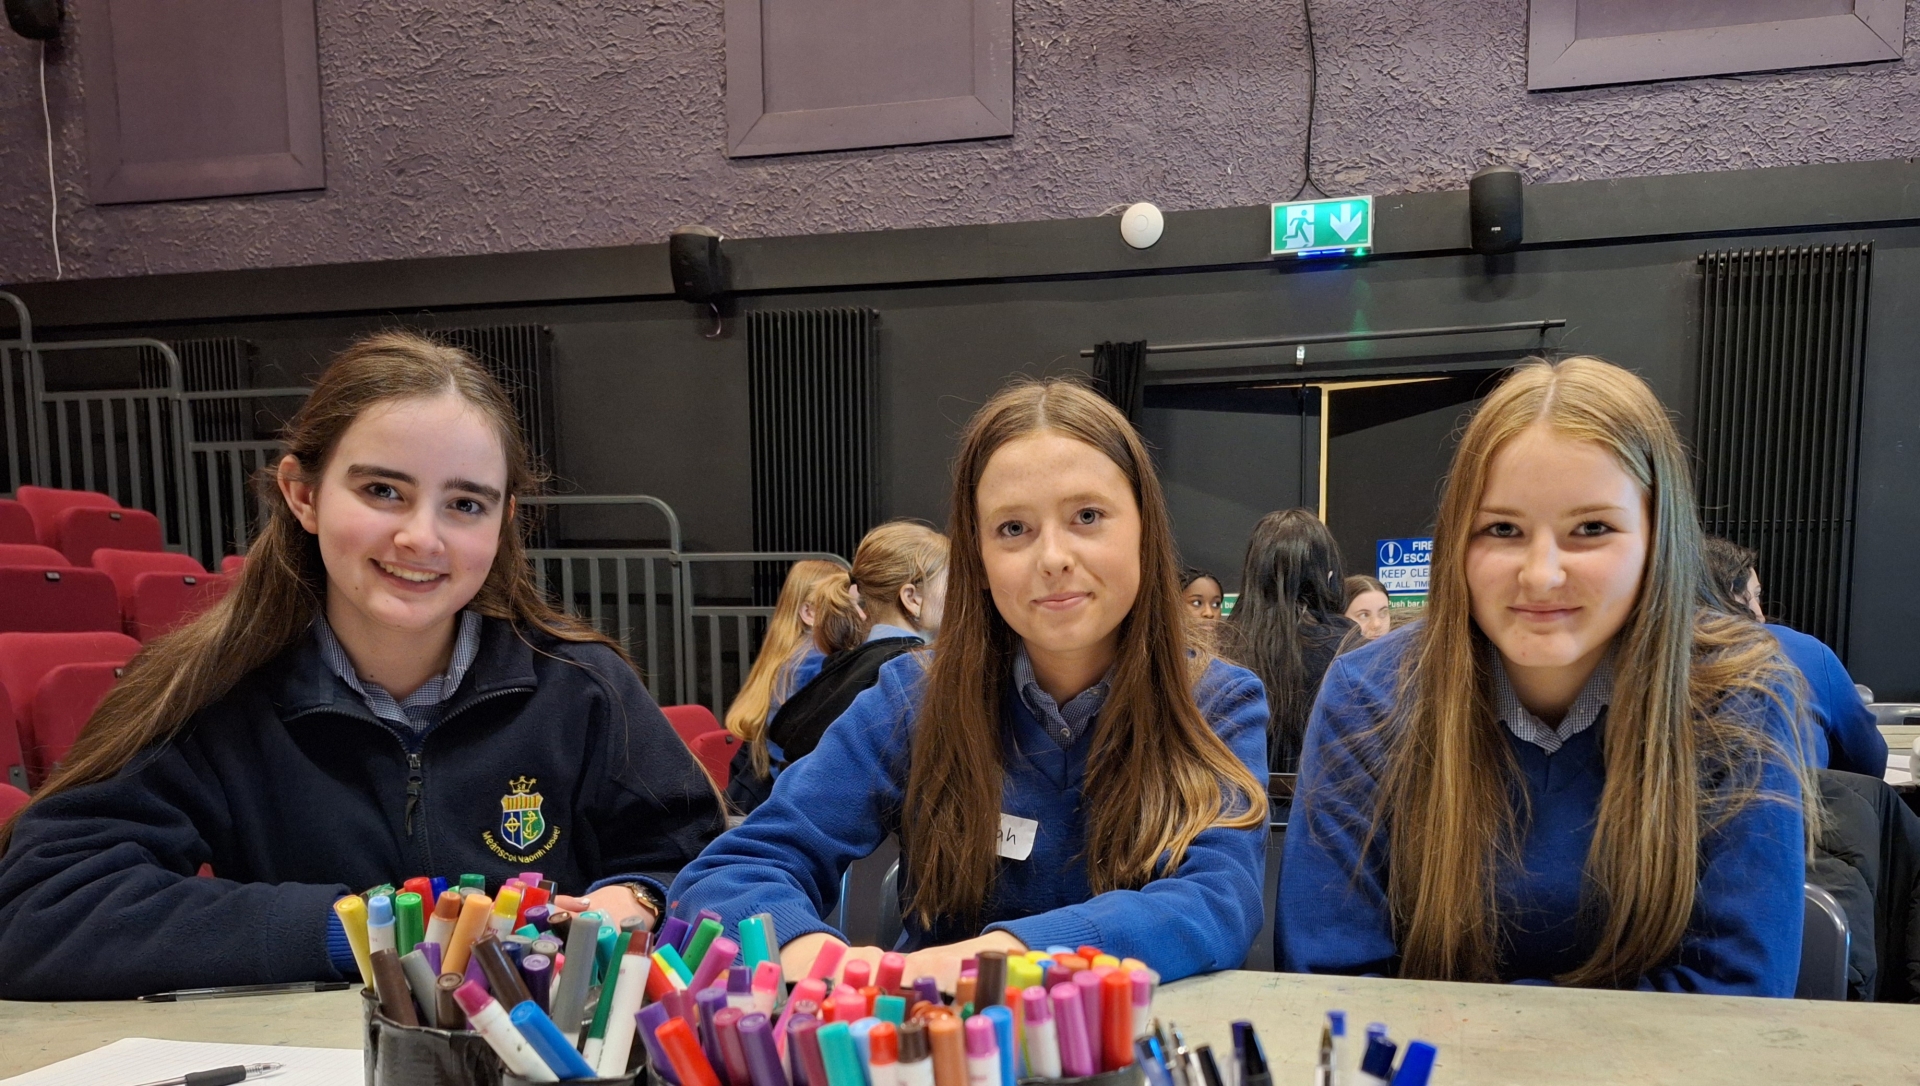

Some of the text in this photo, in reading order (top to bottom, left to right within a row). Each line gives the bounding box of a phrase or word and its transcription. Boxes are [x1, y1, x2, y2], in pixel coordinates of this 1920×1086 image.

[1413, 541, 1433, 551] FIRE
[1403, 553, 1432, 563] ESCA
[1381, 568, 1429, 578] KEEP CLE
[1414, 580, 1429, 588] TIM
[996, 827, 1016, 845] ah
